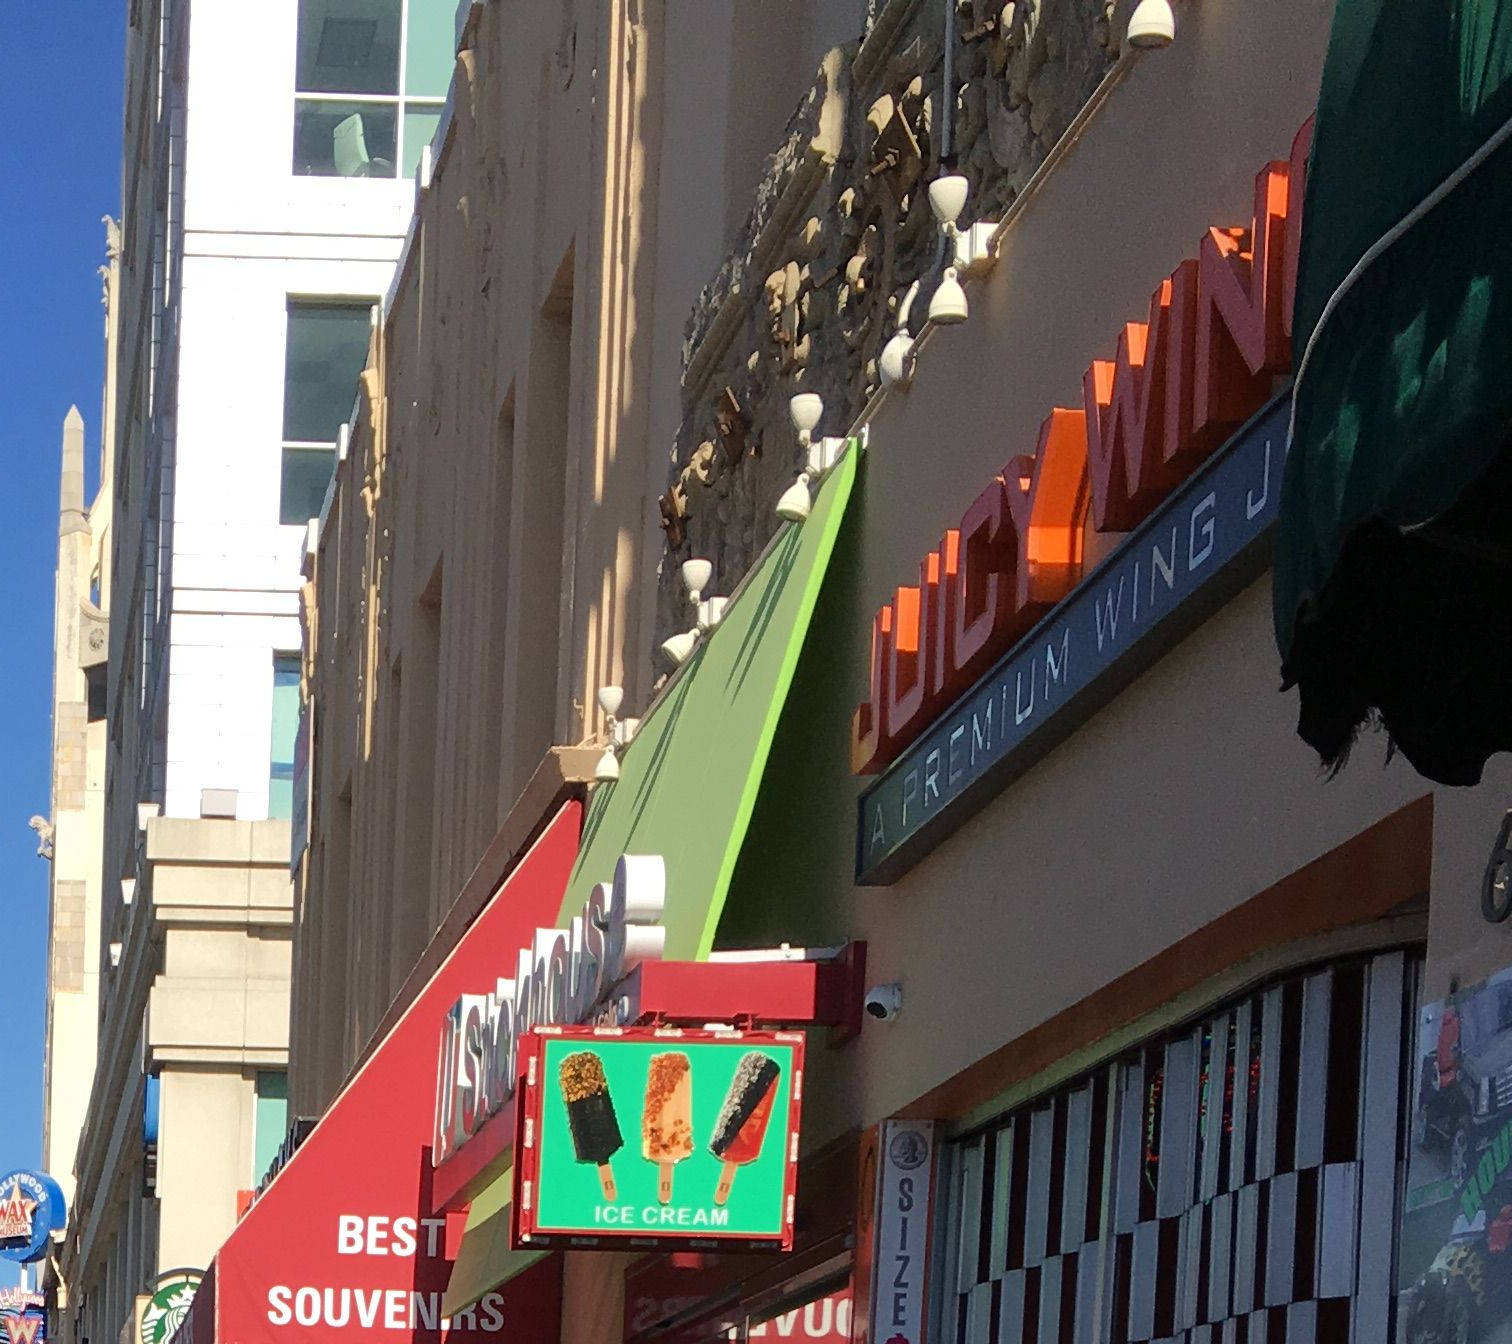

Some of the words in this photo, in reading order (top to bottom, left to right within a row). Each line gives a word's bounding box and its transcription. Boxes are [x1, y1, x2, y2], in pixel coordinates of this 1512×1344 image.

[852, 408, 1085, 775] JUICY
[1084, 110, 1317, 532] WIN
[870, 802, 887, 848] A
[902, 627, 1072, 826] PREMIUM
[1093, 491, 1217, 650] WING
[337, 1216, 446, 1256] BEST
[593, 1205, 637, 1227] ICE
[642, 1206, 730, 1228] CREAM
[891, 1177, 914, 1327] SIZE
[266, 1286, 506, 1333] SOUVENRS
